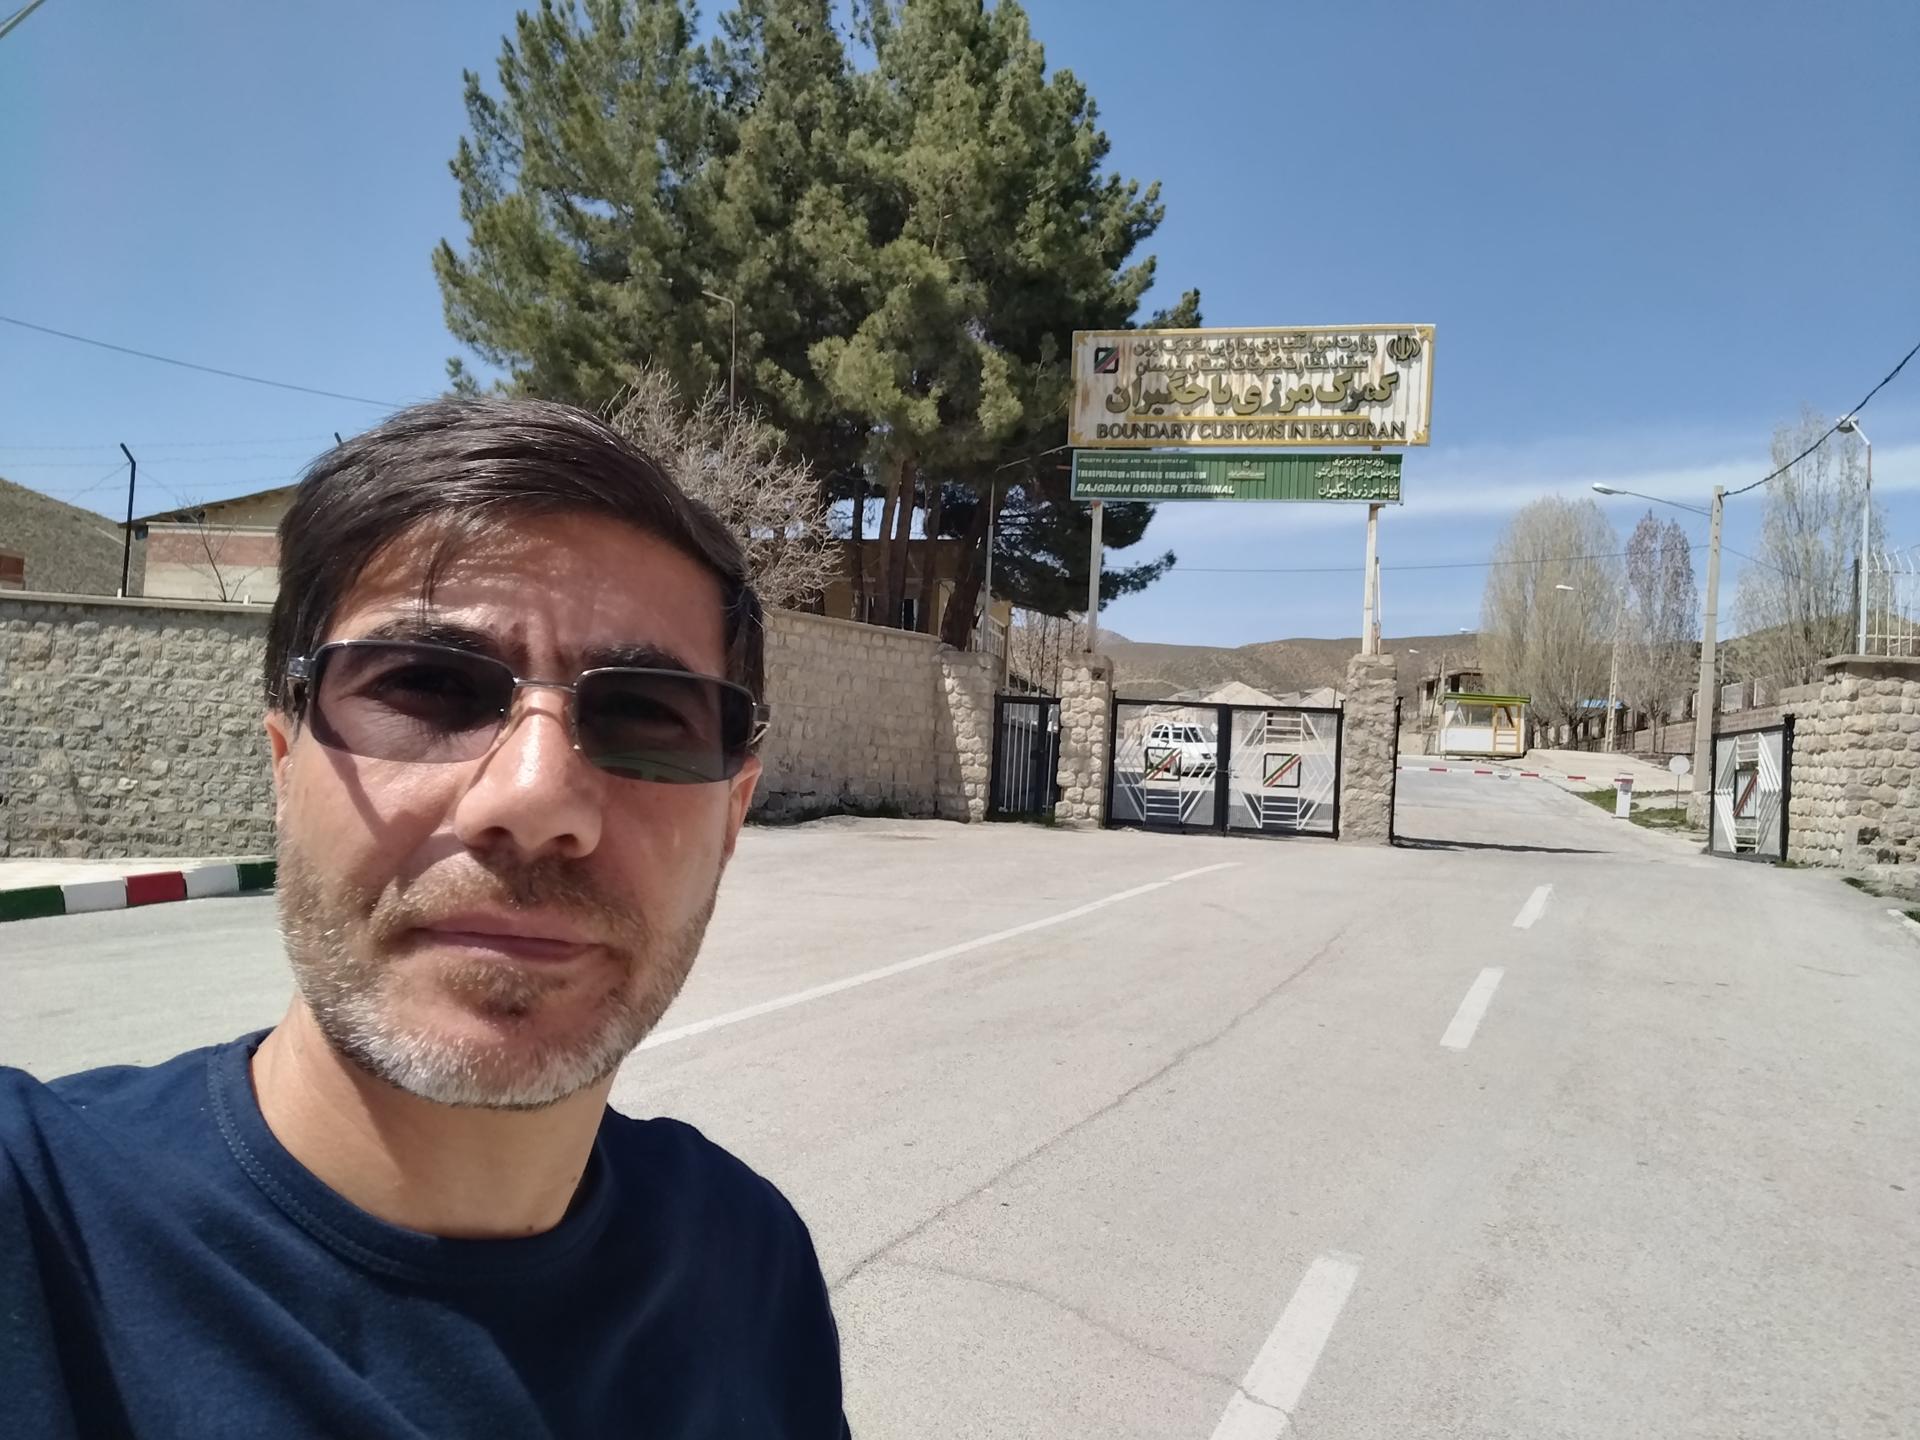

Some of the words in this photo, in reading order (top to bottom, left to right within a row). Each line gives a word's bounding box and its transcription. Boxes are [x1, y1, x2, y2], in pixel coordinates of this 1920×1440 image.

[1096, 422, 1195, 440] BOUNDARY
[1198, 422, 1286, 440] CUSTOMS
[1287, 422, 1306, 440] IN
[1076, 483, 1131, 493] BAJGIRAN
[1132, 483, 1178, 494] BORDER
[1179, 484, 1235, 494] TERMINAL
